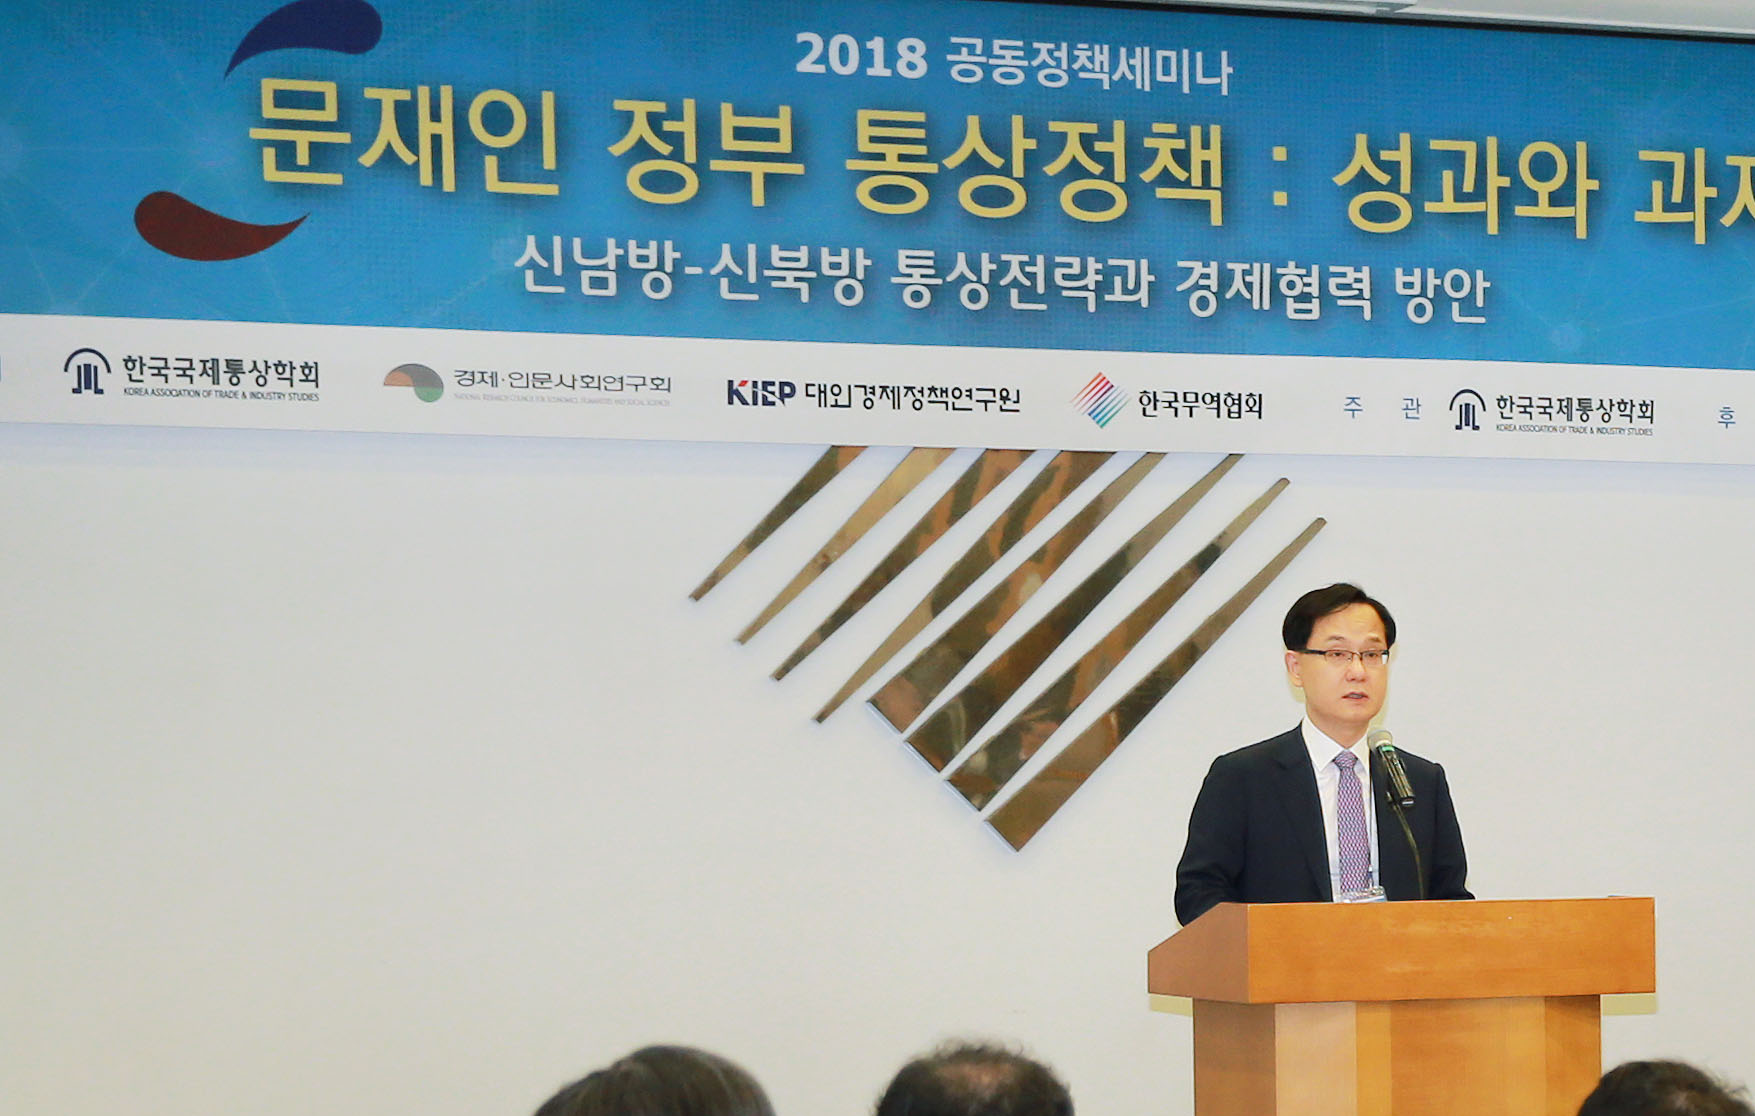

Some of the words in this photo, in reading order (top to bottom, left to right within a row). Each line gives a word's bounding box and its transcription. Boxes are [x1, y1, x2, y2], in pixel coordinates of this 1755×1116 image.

[796, 32, 927, 79] 2018
[947, 37, 1233, 95] 공동정책세미나
[250, 78, 560, 195] 문재인
[608, 99, 805, 206] 정부
[846, 110, 1223, 226] 통상정책
[1273, 146, 1288, 206] :
[1334, 133, 1600, 238] 성과와
[515, 235, 872, 306] 신남방-신북방
[891, 250, 1155, 312] 통상전략과
[1176, 261, 1371, 320] 경제협력
[1396, 268, 1490, 323] 방안
[122, 355, 319, 388] 한국국제통상학회
[455, 370, 670, 392] 경제·인문사회연구회
[123, 388, 149, 397] KOREA
[150, 388, 200, 398] ASSOCIATION
[202, 390, 212, 398] OF
[215, 390, 239, 399] TRADE
[250, 391, 286, 400] INDUSTRY
[288, 392, 319, 401] STUDIES
[728, 380, 796, 406] KIEP
[806, 384, 1019, 412] 대외경제정책연구원
[1139, 391, 1262, 419] 한국무역협회
[1495, 394, 1654, 424] 한국국제통상학회
